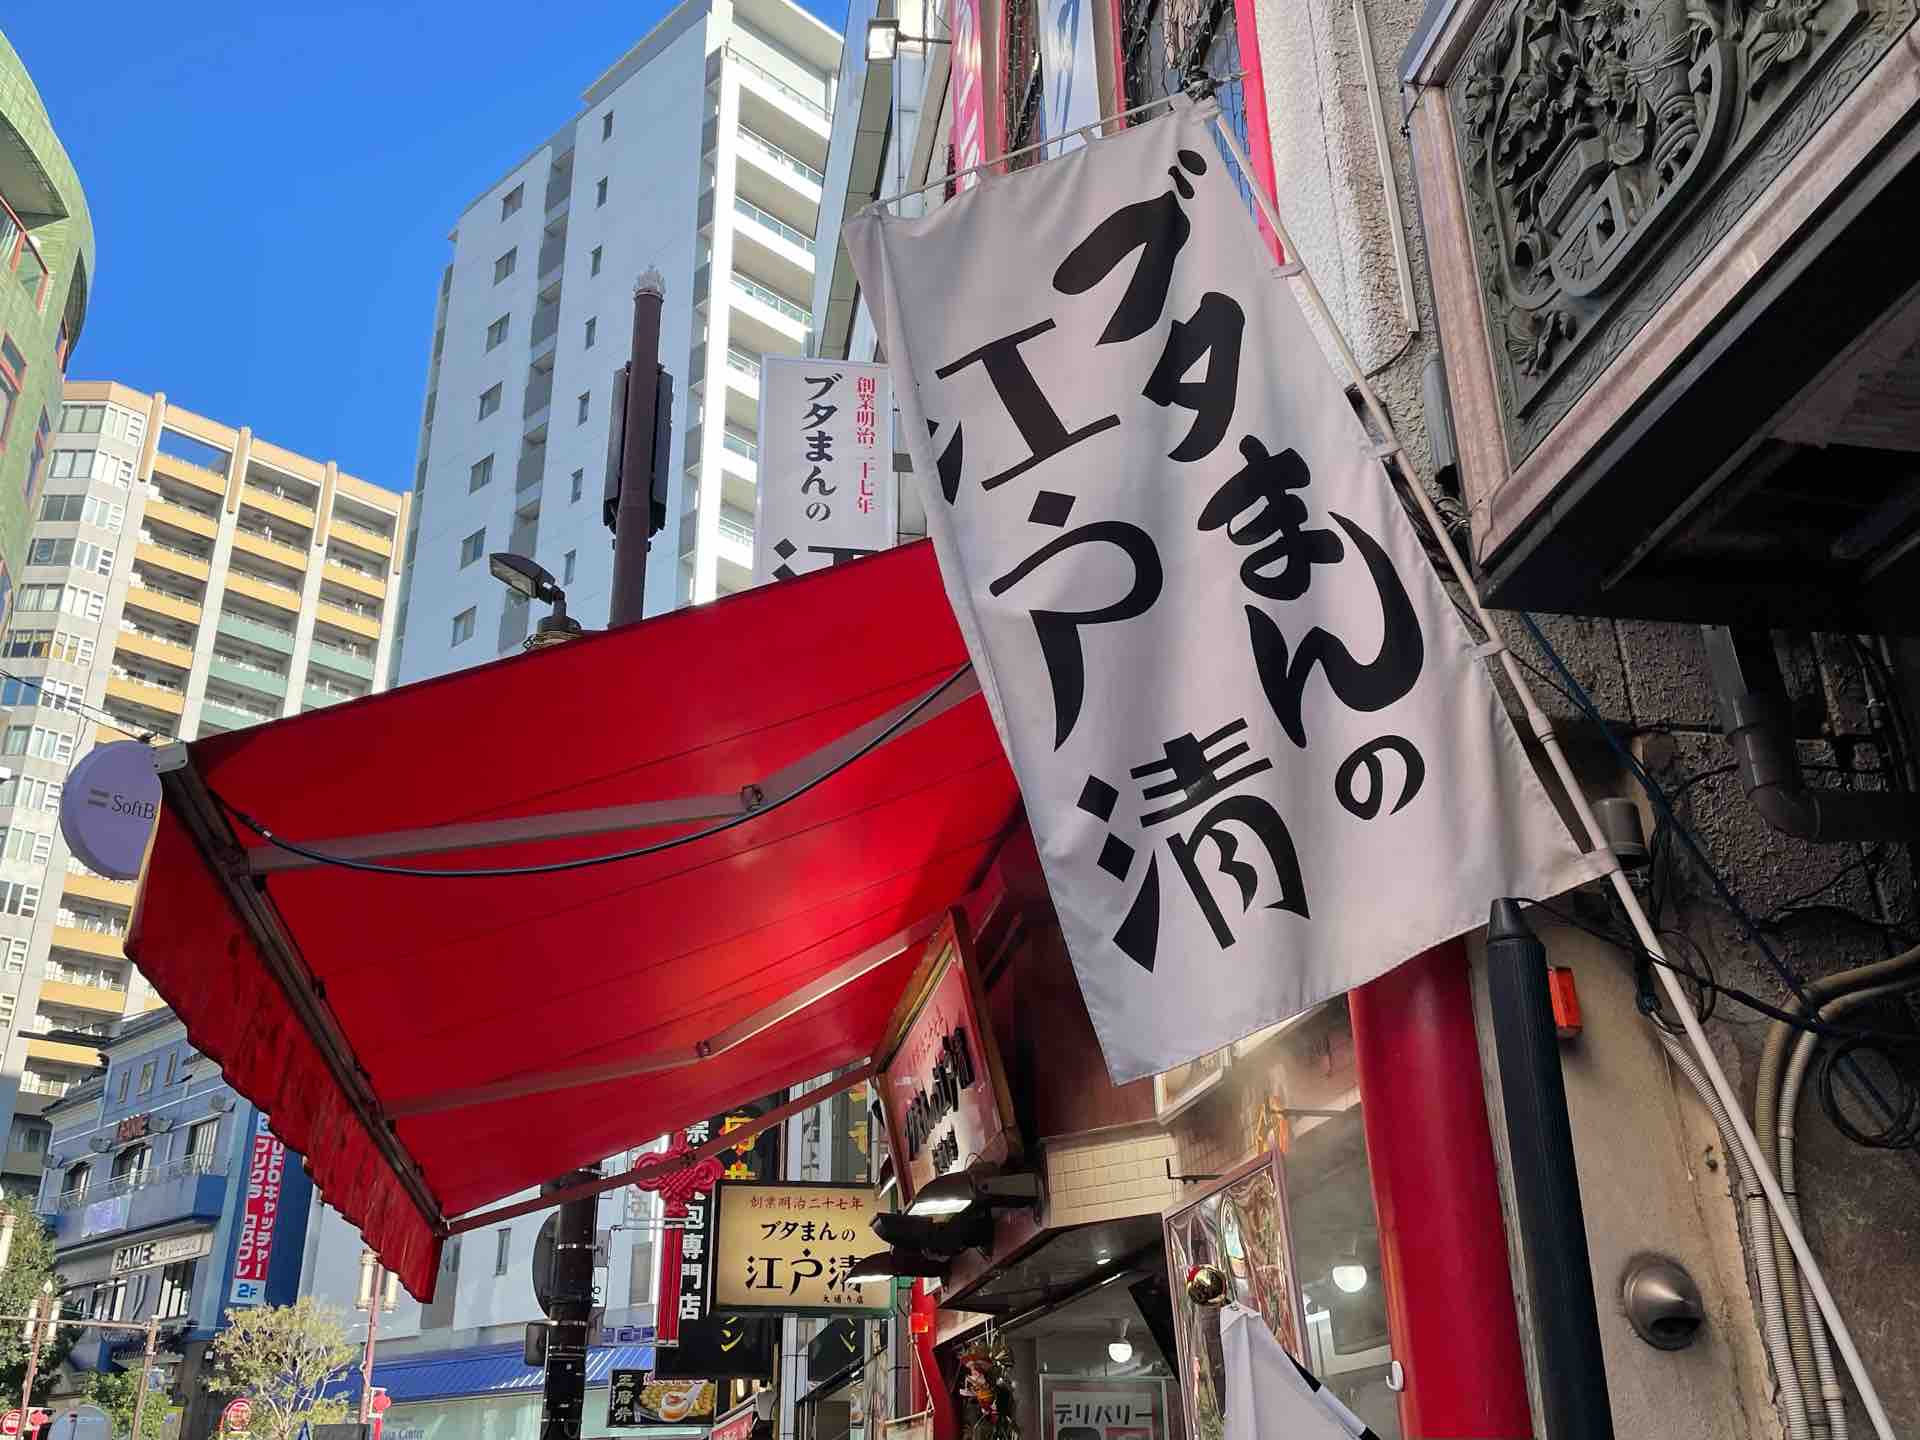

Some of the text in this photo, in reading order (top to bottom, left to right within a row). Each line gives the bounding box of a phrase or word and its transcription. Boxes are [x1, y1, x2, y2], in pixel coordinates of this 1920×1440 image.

[800, 372, 844, 522] ブタまんの
[856, 376, 876, 515] 創業明治二十七年
[1053, 149, 1424, 821] ブタまんの
[928, 317, 1310, 973] 江戸清
[112, 795, 156, 821] SoftB
[255, 1141, 284, 1278] UFOキャッチャー
[751, 1196, 864, 1211] 創業明治二十七年
[760, 1220, 856, 1242] ブタまんの
[238, 1284, 258, 1298] 2F
[1055, 1403, 1153, 1425] デリバリー
